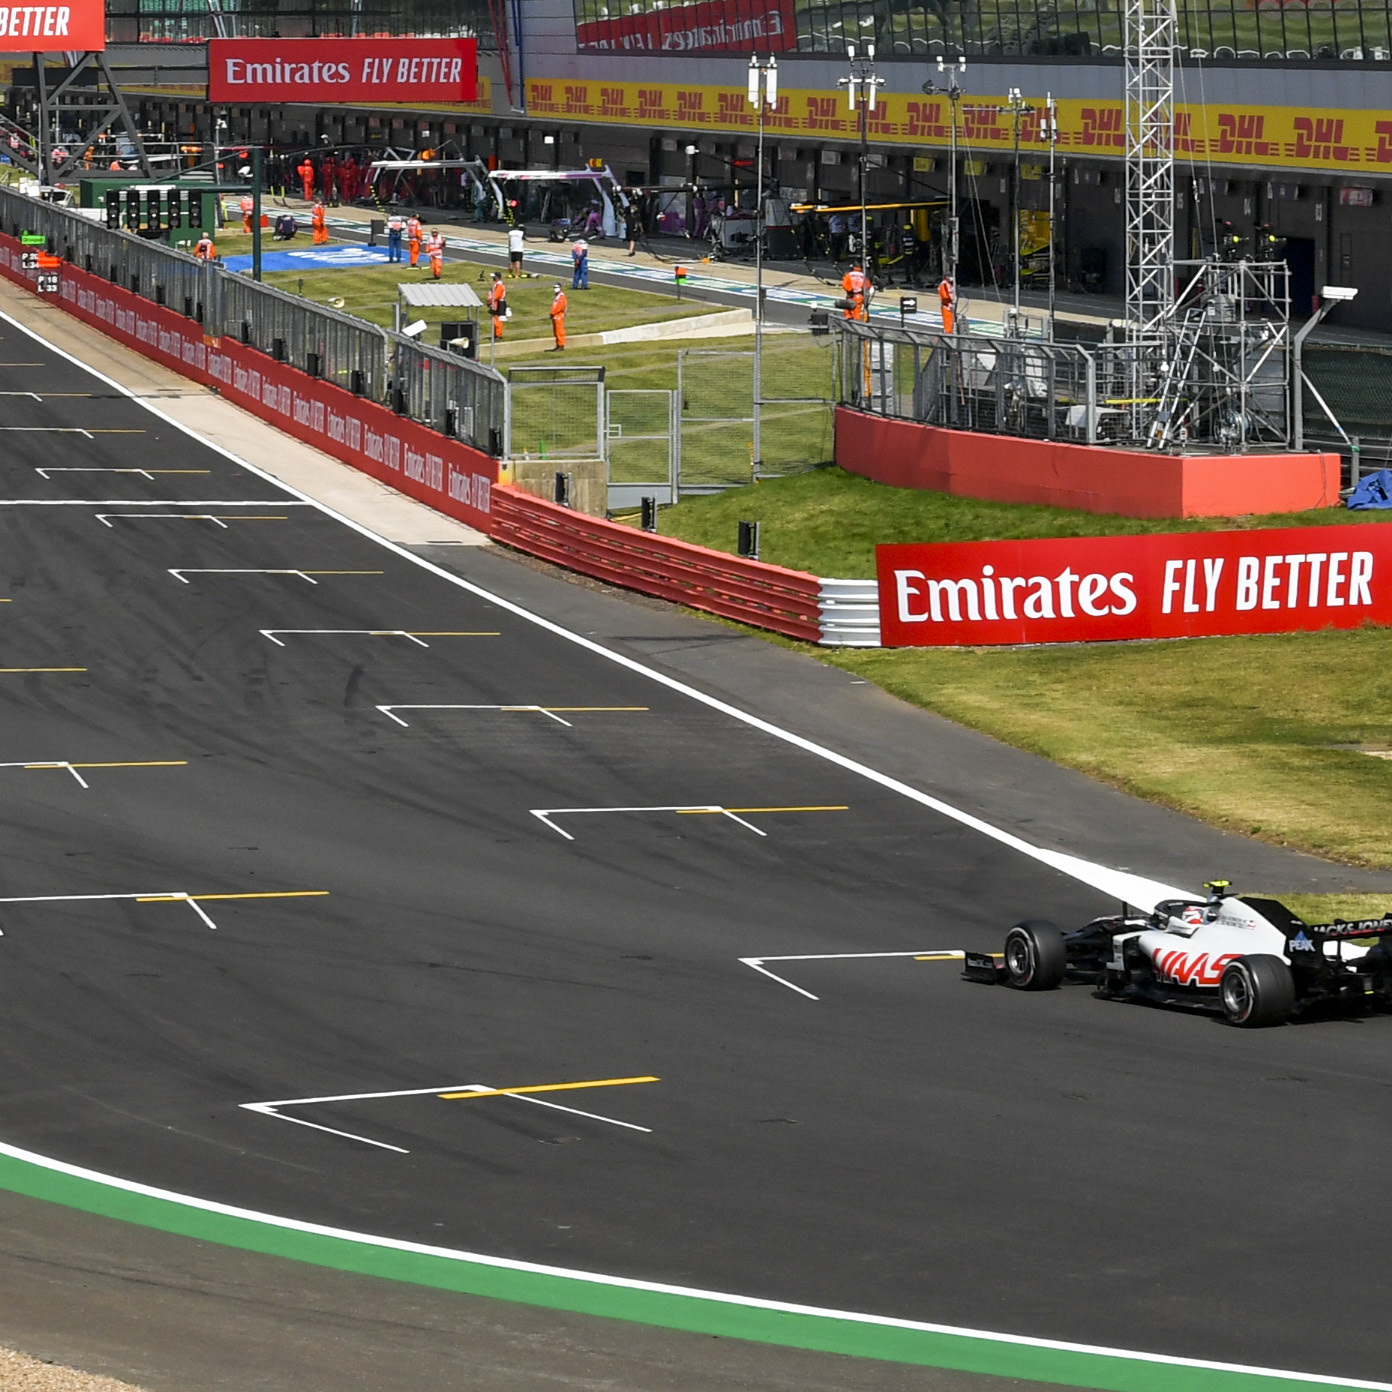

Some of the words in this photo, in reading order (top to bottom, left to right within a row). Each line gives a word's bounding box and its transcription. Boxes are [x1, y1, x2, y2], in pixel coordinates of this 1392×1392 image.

[225, 57, 351, 84] Emirates
[361, 57, 394, 83] FLY
[396, 58, 463, 84] BETTER
[634, 89, 670, 120] DHL
[671, 91, 709, 122] DHL
[711, 93, 753, 125] DHL
[800, 97, 846, 131] DHL
[903, 102, 954, 138] DHL
[1209, 113, 1279, 157] DHL
[1285, 116, 1360, 163] DHL
[893, 564, 1138, 623] Emirates
[1161, 558, 1224, 614] FLY
[1235, 551, 1374, 611] BETTER
[1288, 939, 1317, 953] PEAK
[1152, 947, 1245, 987] HAAS
